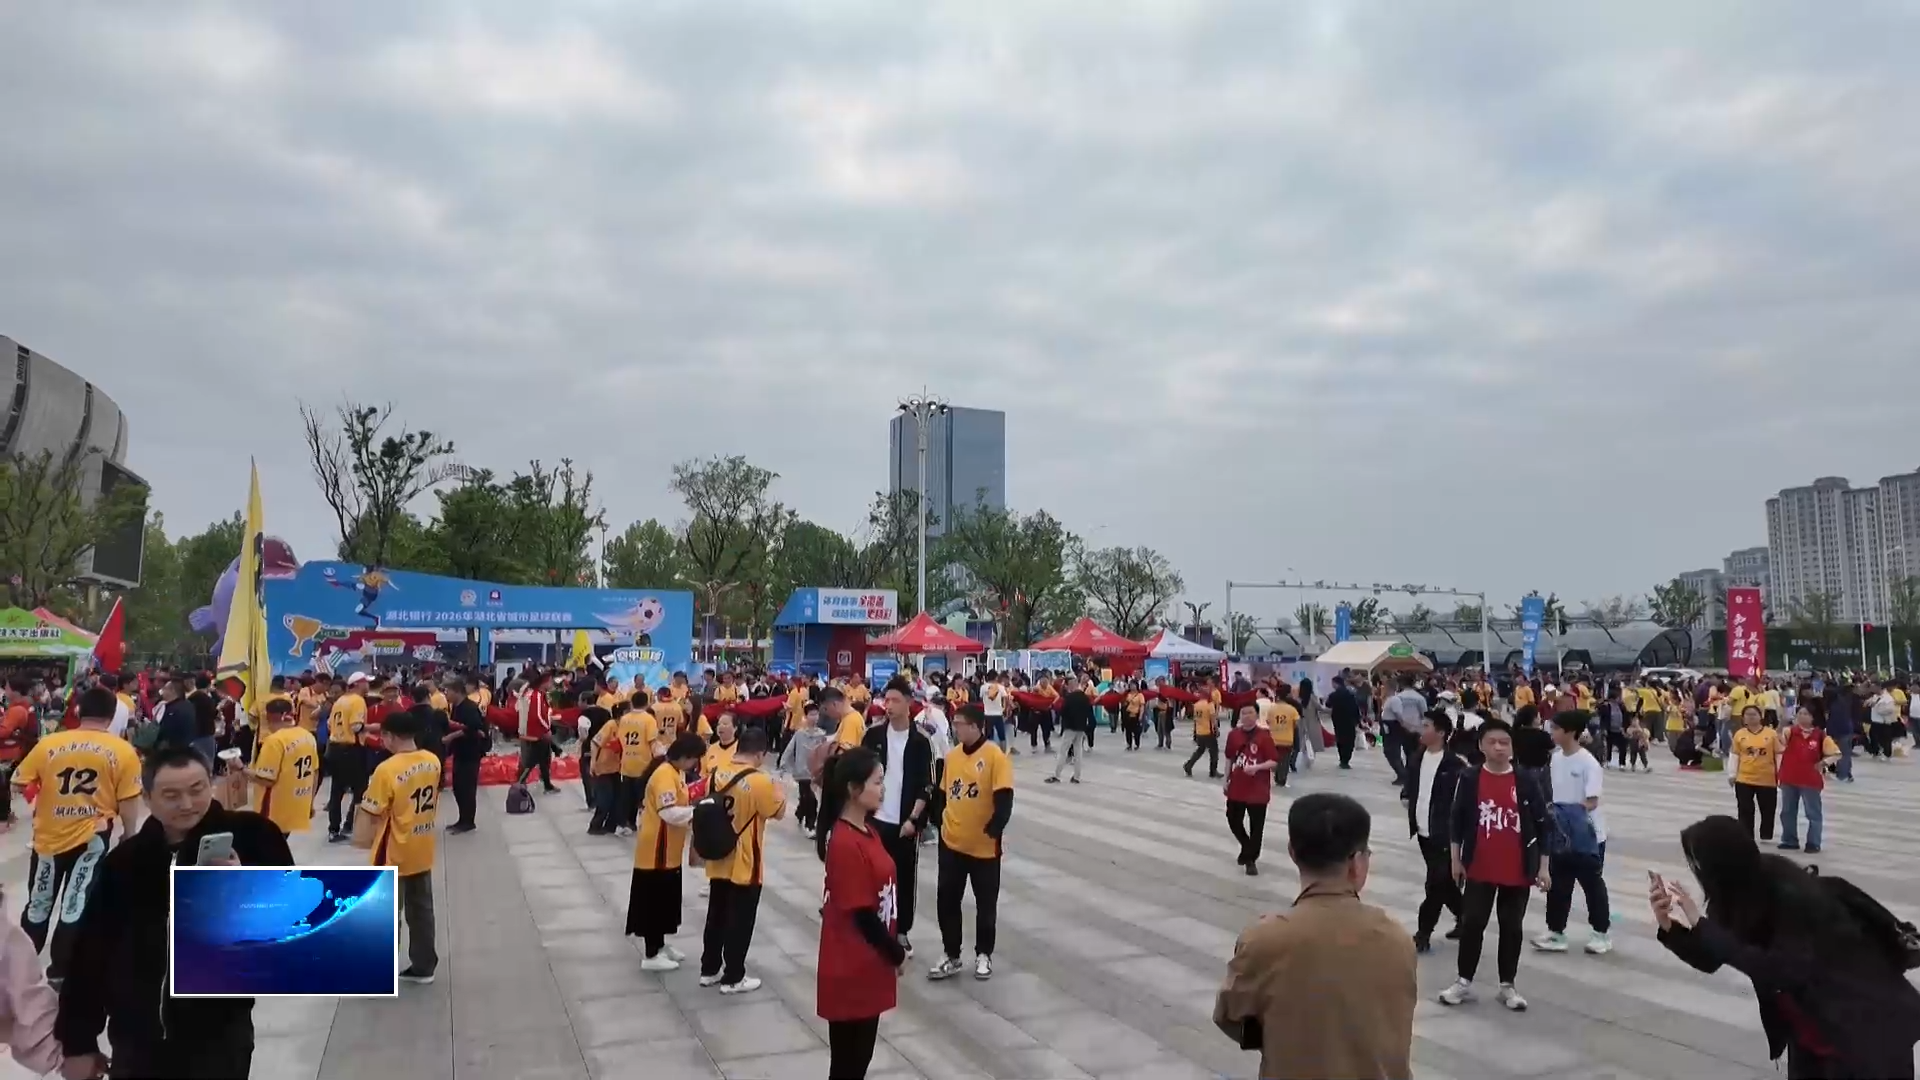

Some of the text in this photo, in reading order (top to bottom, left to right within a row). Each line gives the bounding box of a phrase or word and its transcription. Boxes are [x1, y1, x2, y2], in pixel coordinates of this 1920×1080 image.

[662, 716, 675, 728] 12
[1275, 714, 1288, 725] 12
[625, 731, 640, 746] 12
[294, 755, 312, 780] 12
[56, 766, 98, 795] 12
[949, 777, 979, 800] 黄石
[410, 785, 434, 814] 12
[1478, 798, 1521, 840] 荆门
